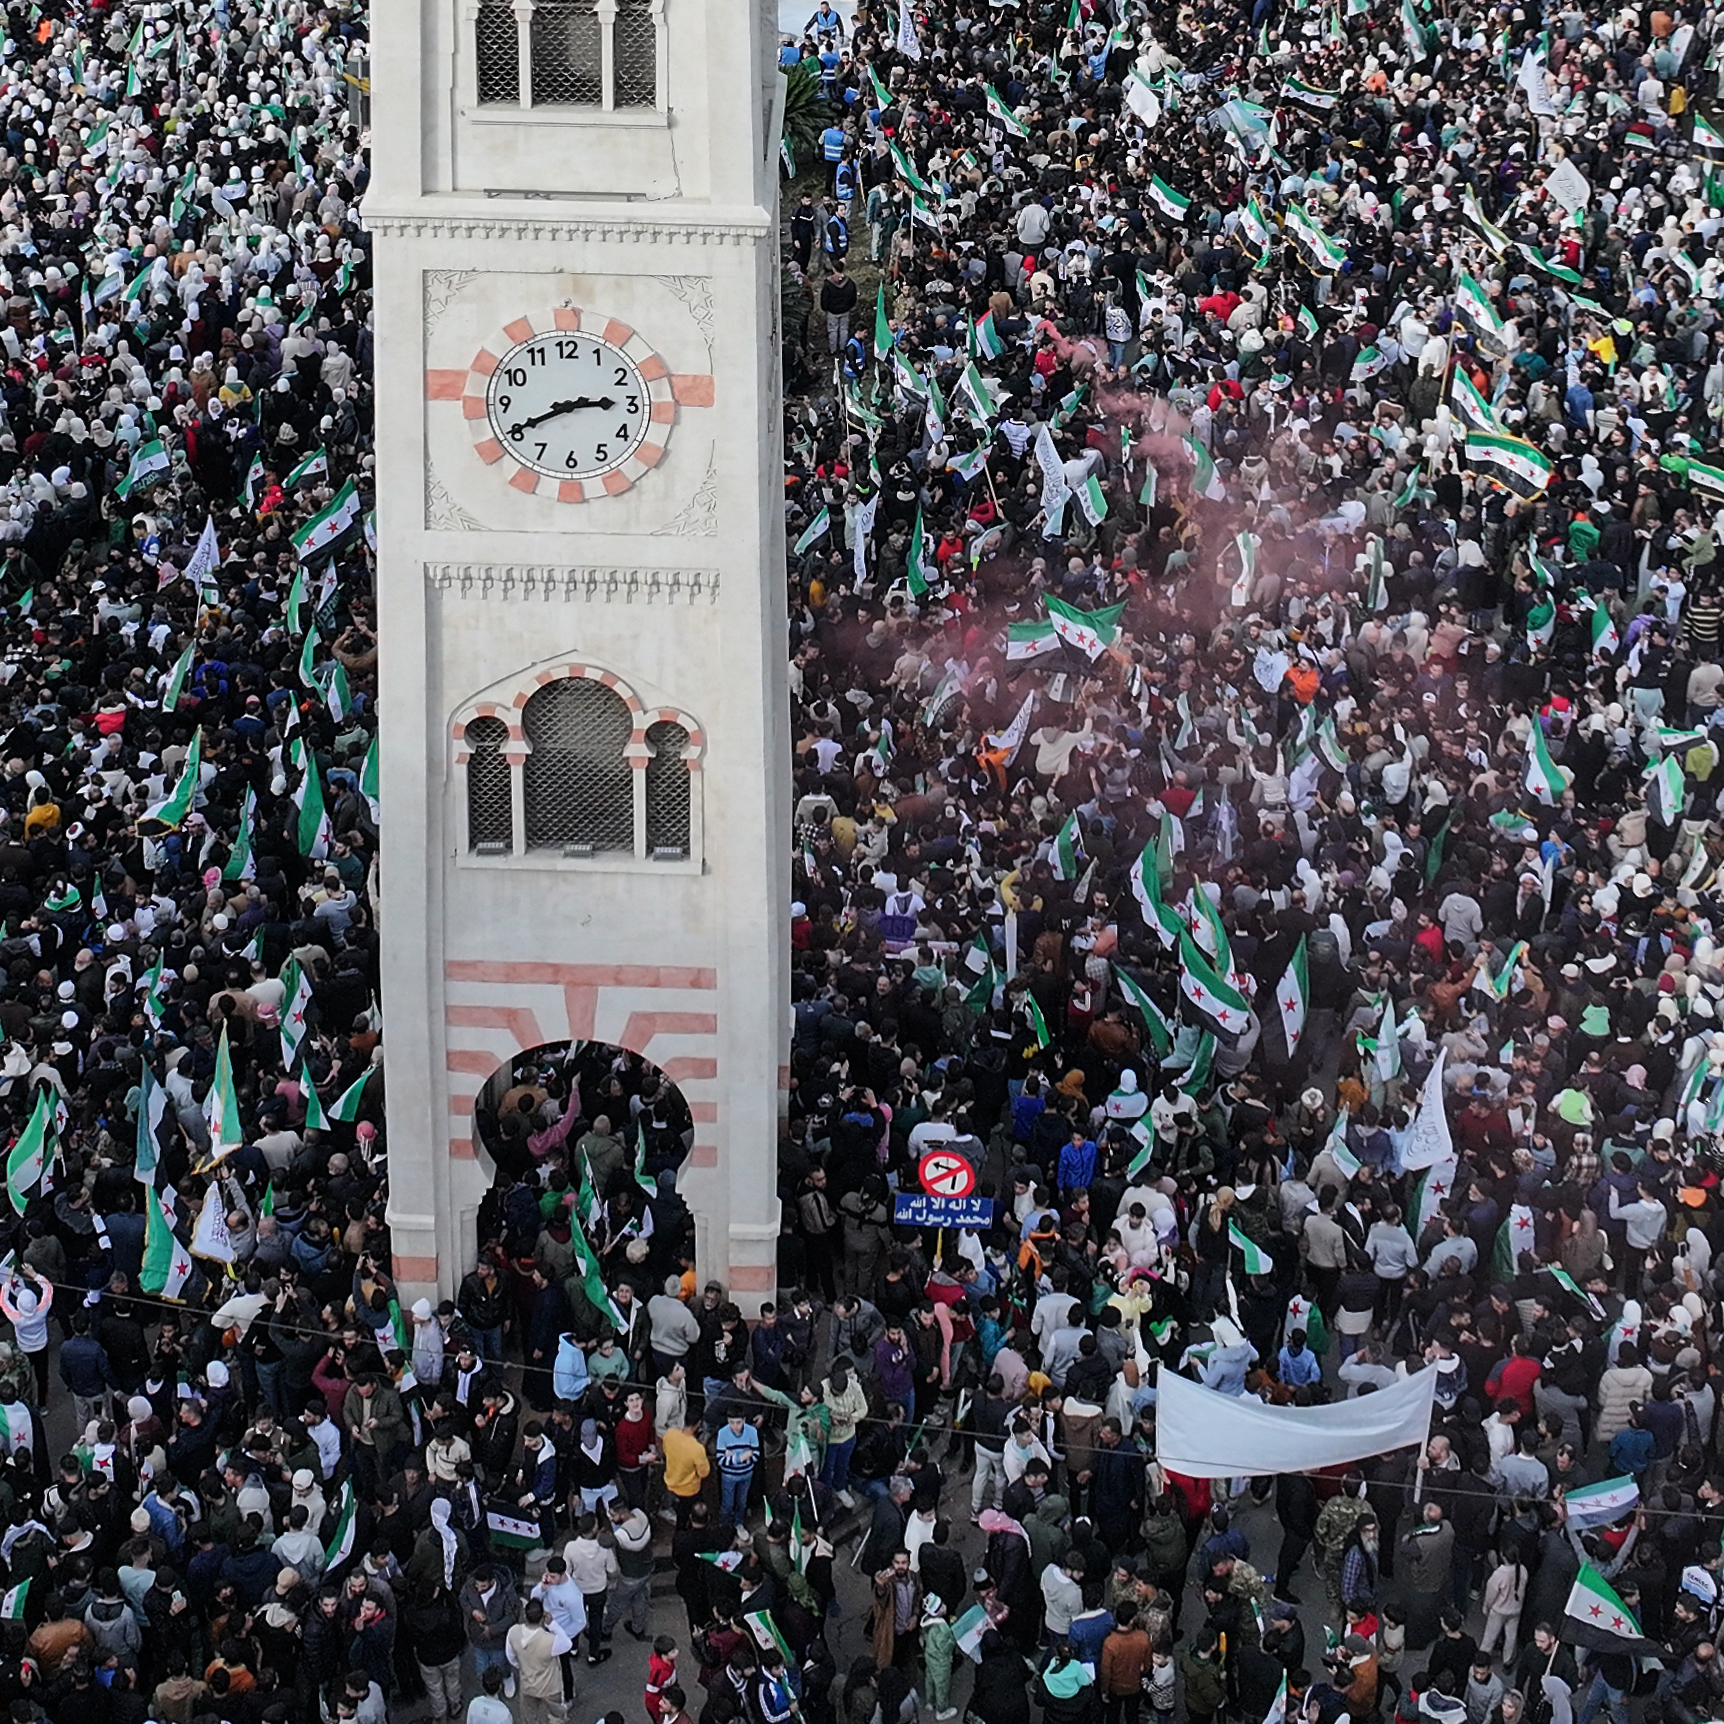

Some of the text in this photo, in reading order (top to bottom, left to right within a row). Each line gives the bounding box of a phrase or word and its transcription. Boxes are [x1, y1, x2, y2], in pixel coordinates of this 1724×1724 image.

[526, 347, 546, 366] 11
[555, 340, 579, 359] 12
[592, 348, 601, 366] 1
[504, 368, 527, 387] 10
[614, 367, 628, 386] 2
[499, 395, 511, 414] 9
[626, 395, 639, 414] 3
[511, 423, 525, 442] 8
[615, 423, 629, 442] 4
[534, 442, 547, 461] 7
[565, 450, 578, 469] 6
[595, 443, 608, 462] 5
[910, 1196, 926, 1209] الله
[970, 1198, 982, 1212] لا
[895, 1207, 991, 1227] محمد رسول الله
